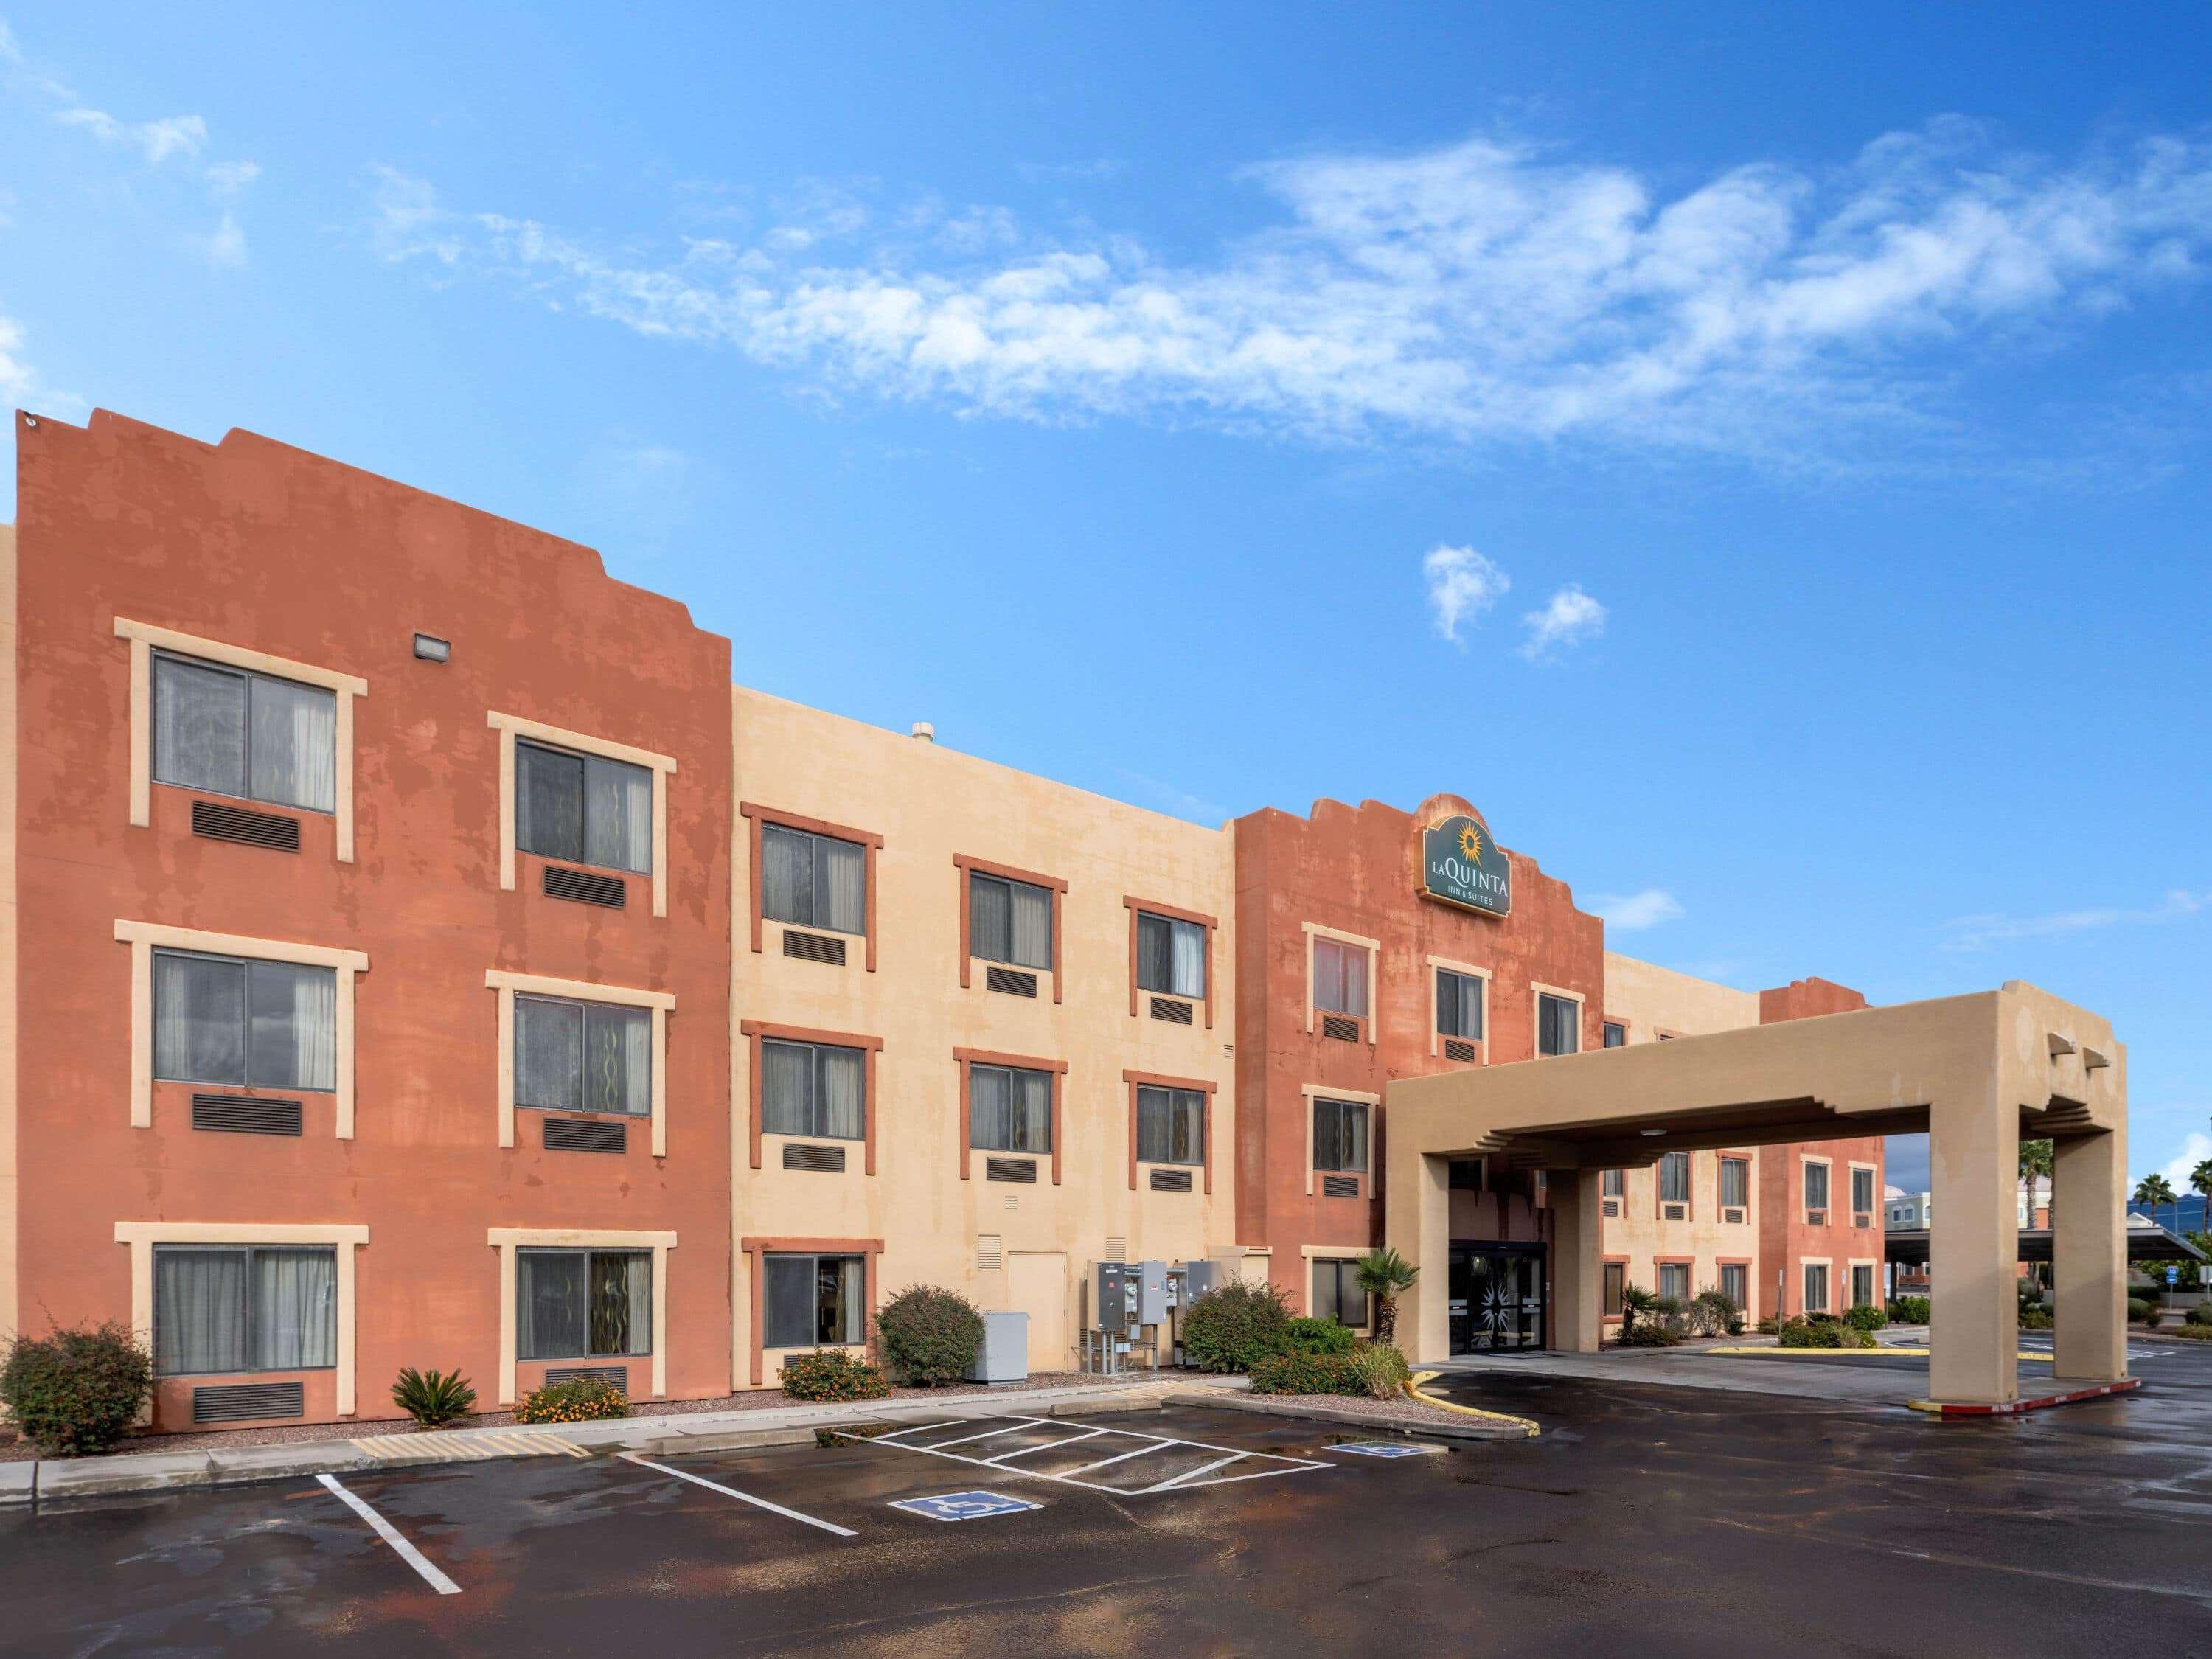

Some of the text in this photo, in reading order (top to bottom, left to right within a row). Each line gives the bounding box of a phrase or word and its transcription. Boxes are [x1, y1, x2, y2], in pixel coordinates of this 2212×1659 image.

[1433, 858, 1508, 897] LA QUINTA
[1448, 885, 1461, 895] INN
[1468, 891, 1492, 905] SUITES
